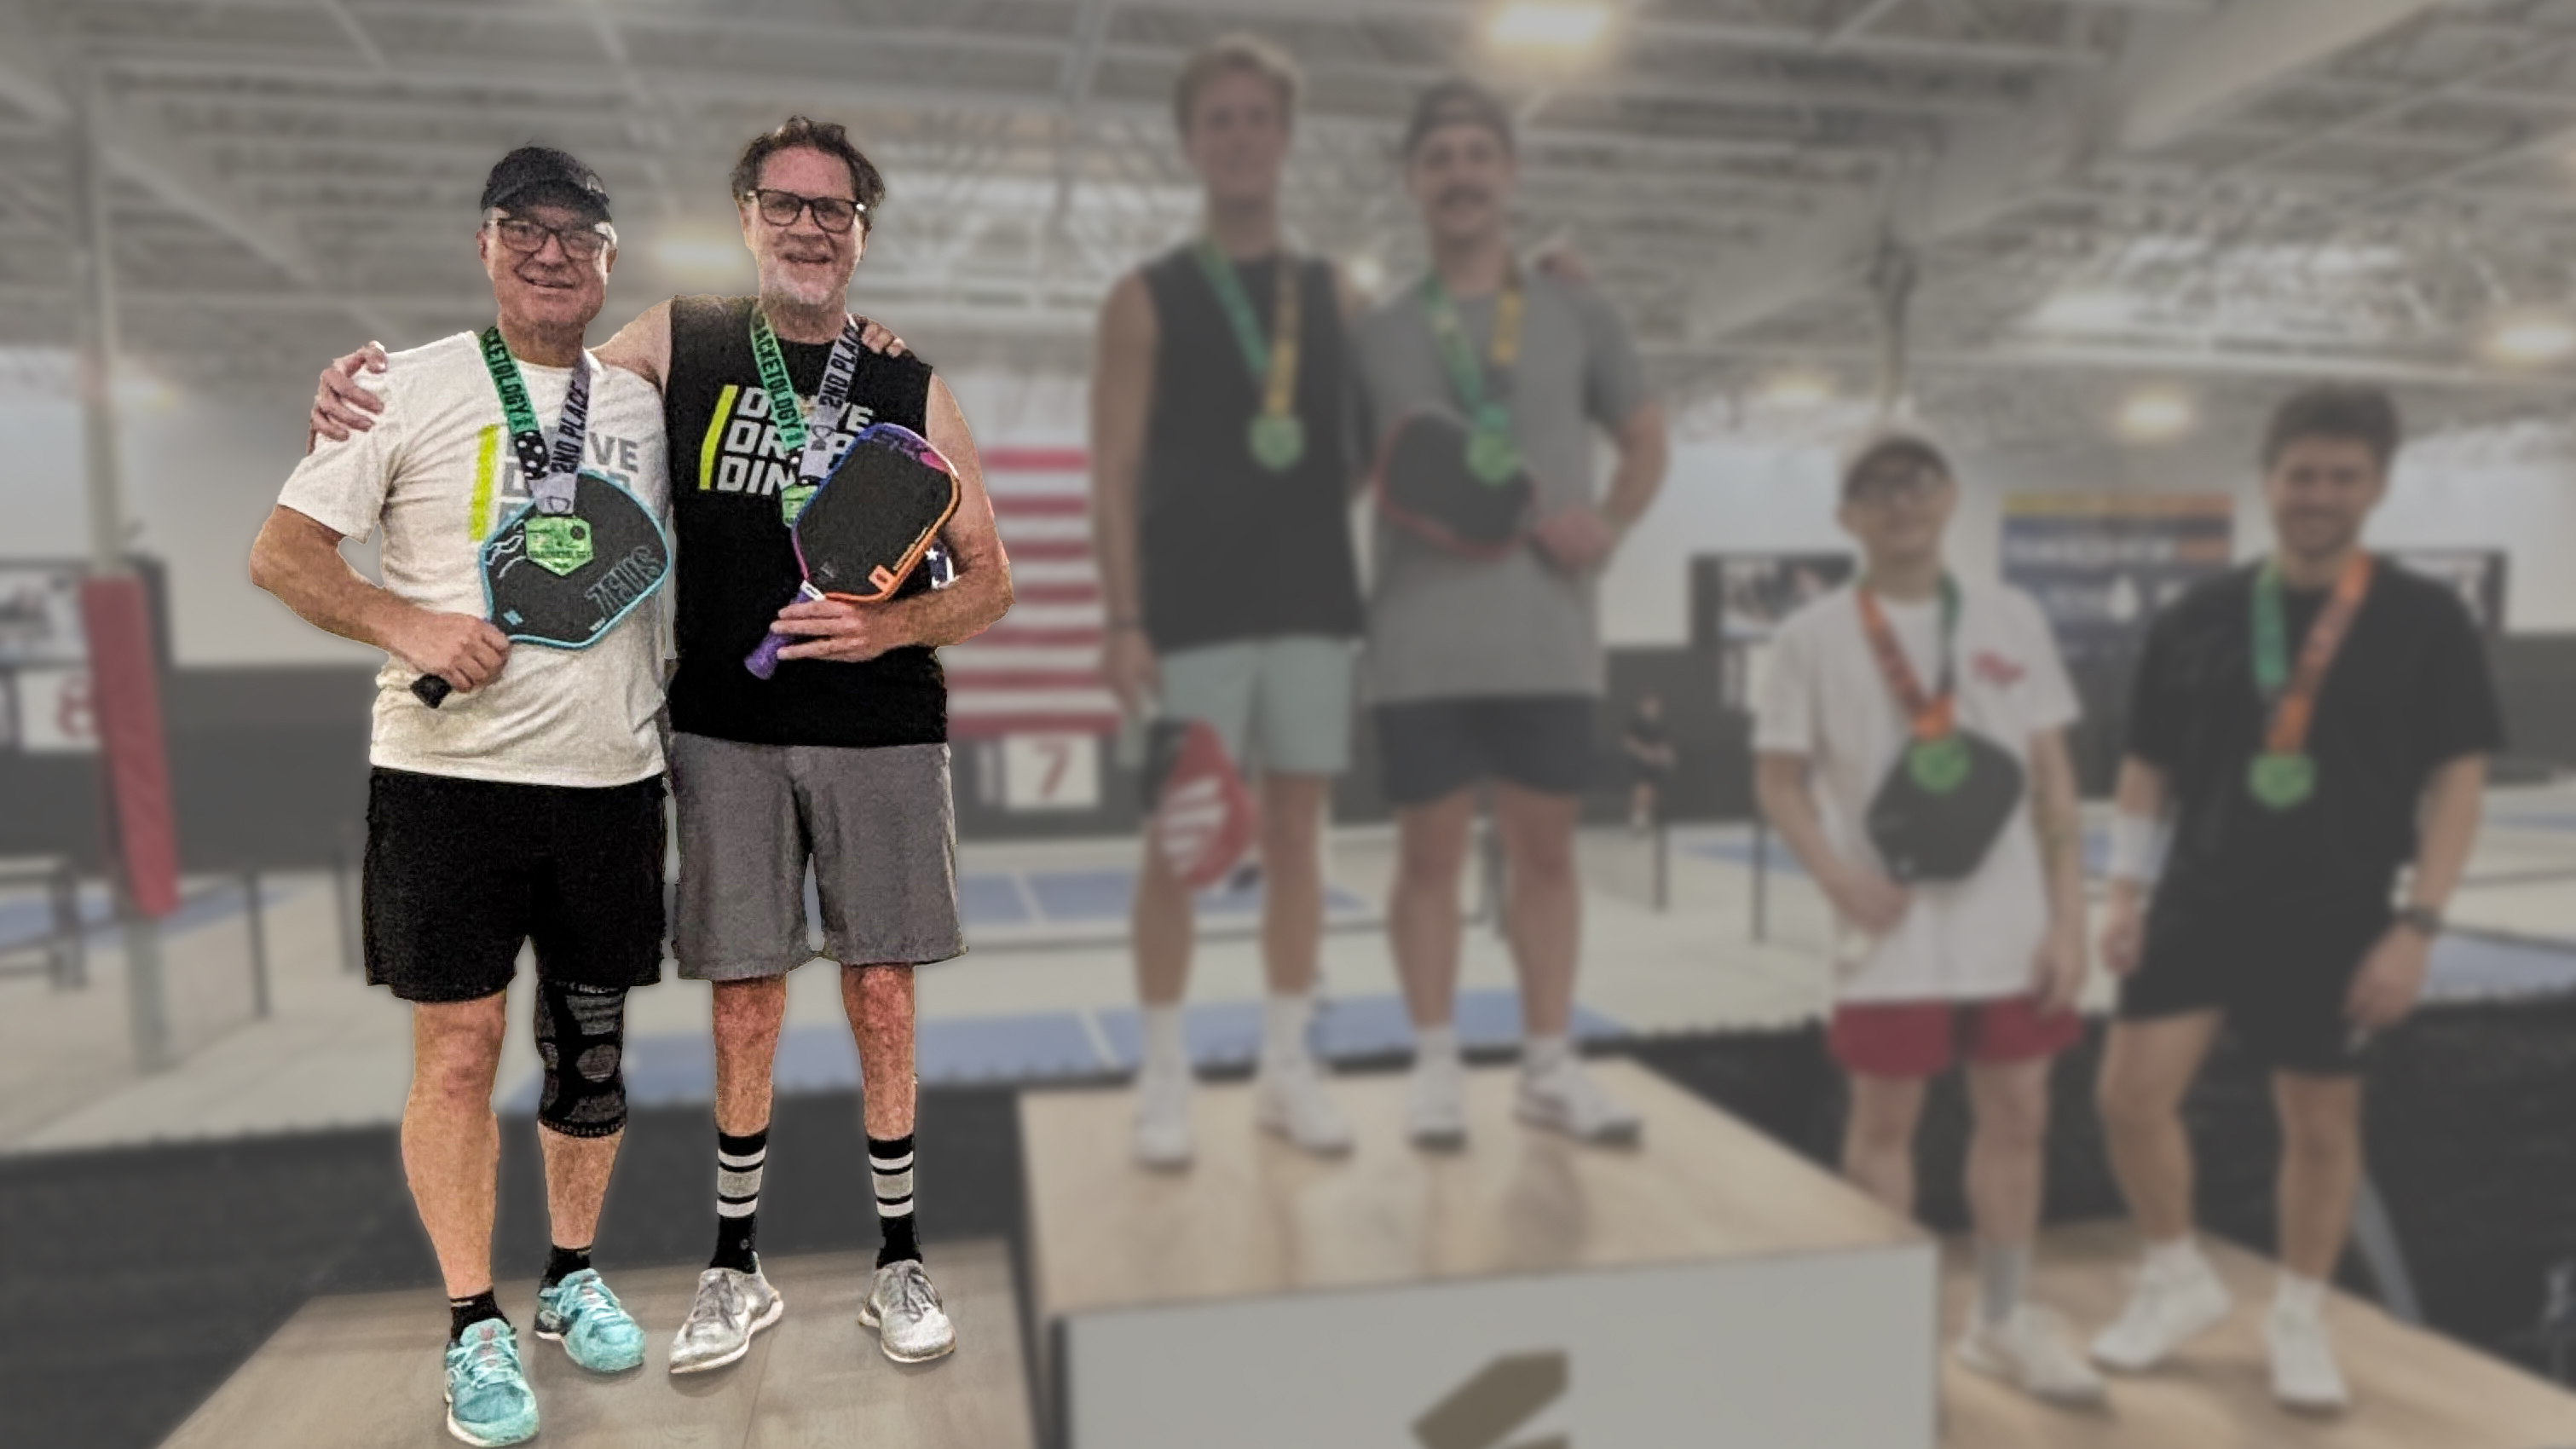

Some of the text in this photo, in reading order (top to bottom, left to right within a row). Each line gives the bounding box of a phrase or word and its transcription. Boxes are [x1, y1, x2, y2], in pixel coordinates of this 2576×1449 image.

[817, 322, 860, 408] 2ND PLAC
[550, 440, 580, 474] 2ND
[717, 454, 798, 496] DIN
[584, 546, 662, 617] ZEUS
[1033, 736, 1072, 800] 7
